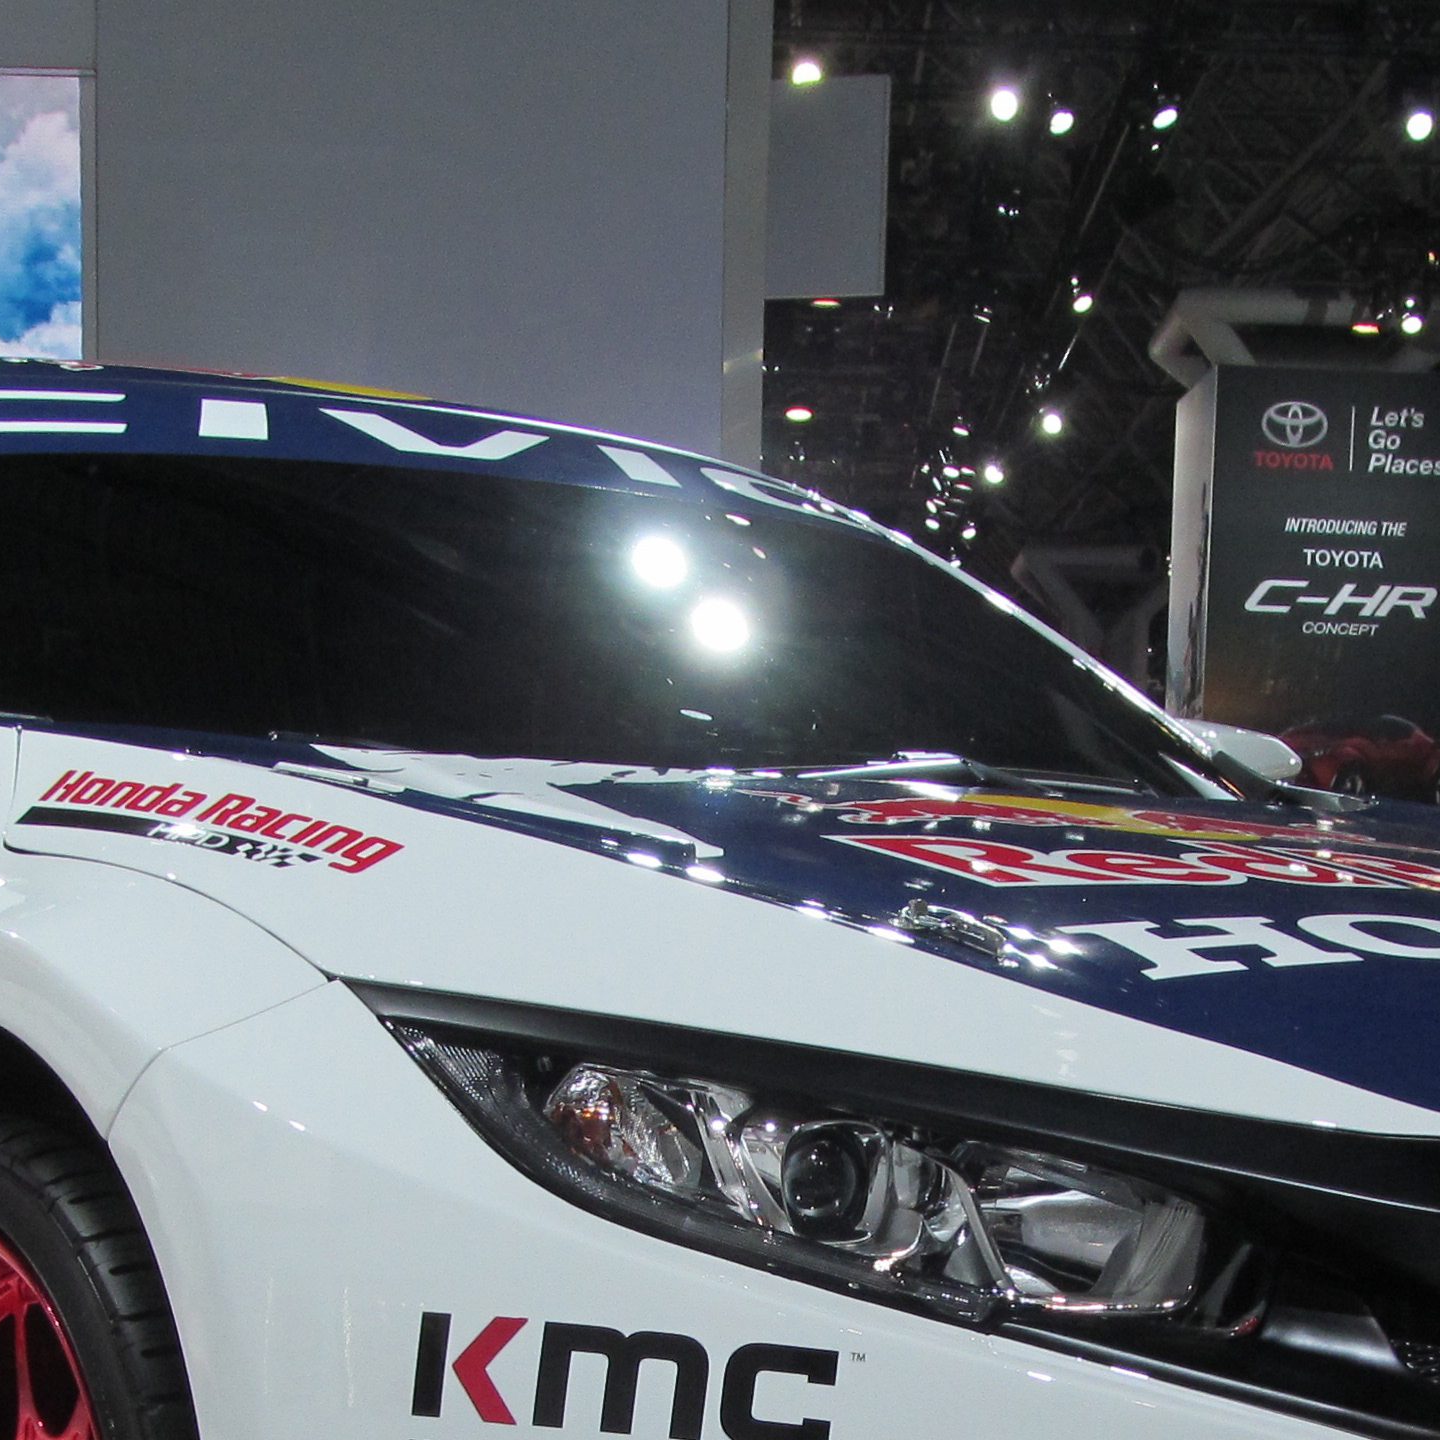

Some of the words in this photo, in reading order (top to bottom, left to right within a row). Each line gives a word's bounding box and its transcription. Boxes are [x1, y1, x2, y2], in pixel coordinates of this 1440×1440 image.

[1371, 406, 1425, 428] Let's
[1368, 430, 1401, 450] Go
[1254, 450, 1334, 472] TOYOTA
[1284, 517, 1379, 537] INTRODUCING
[1380, 521, 1407, 537] THE
[1303, 549, 1384, 569] TOYOTA
[1244, 579, 1438, 620] C-HR
[1302, 621, 1379, 637] CONCEPT
[38, 769, 201, 819] Honda
[195, 792, 406, 874] Racing
